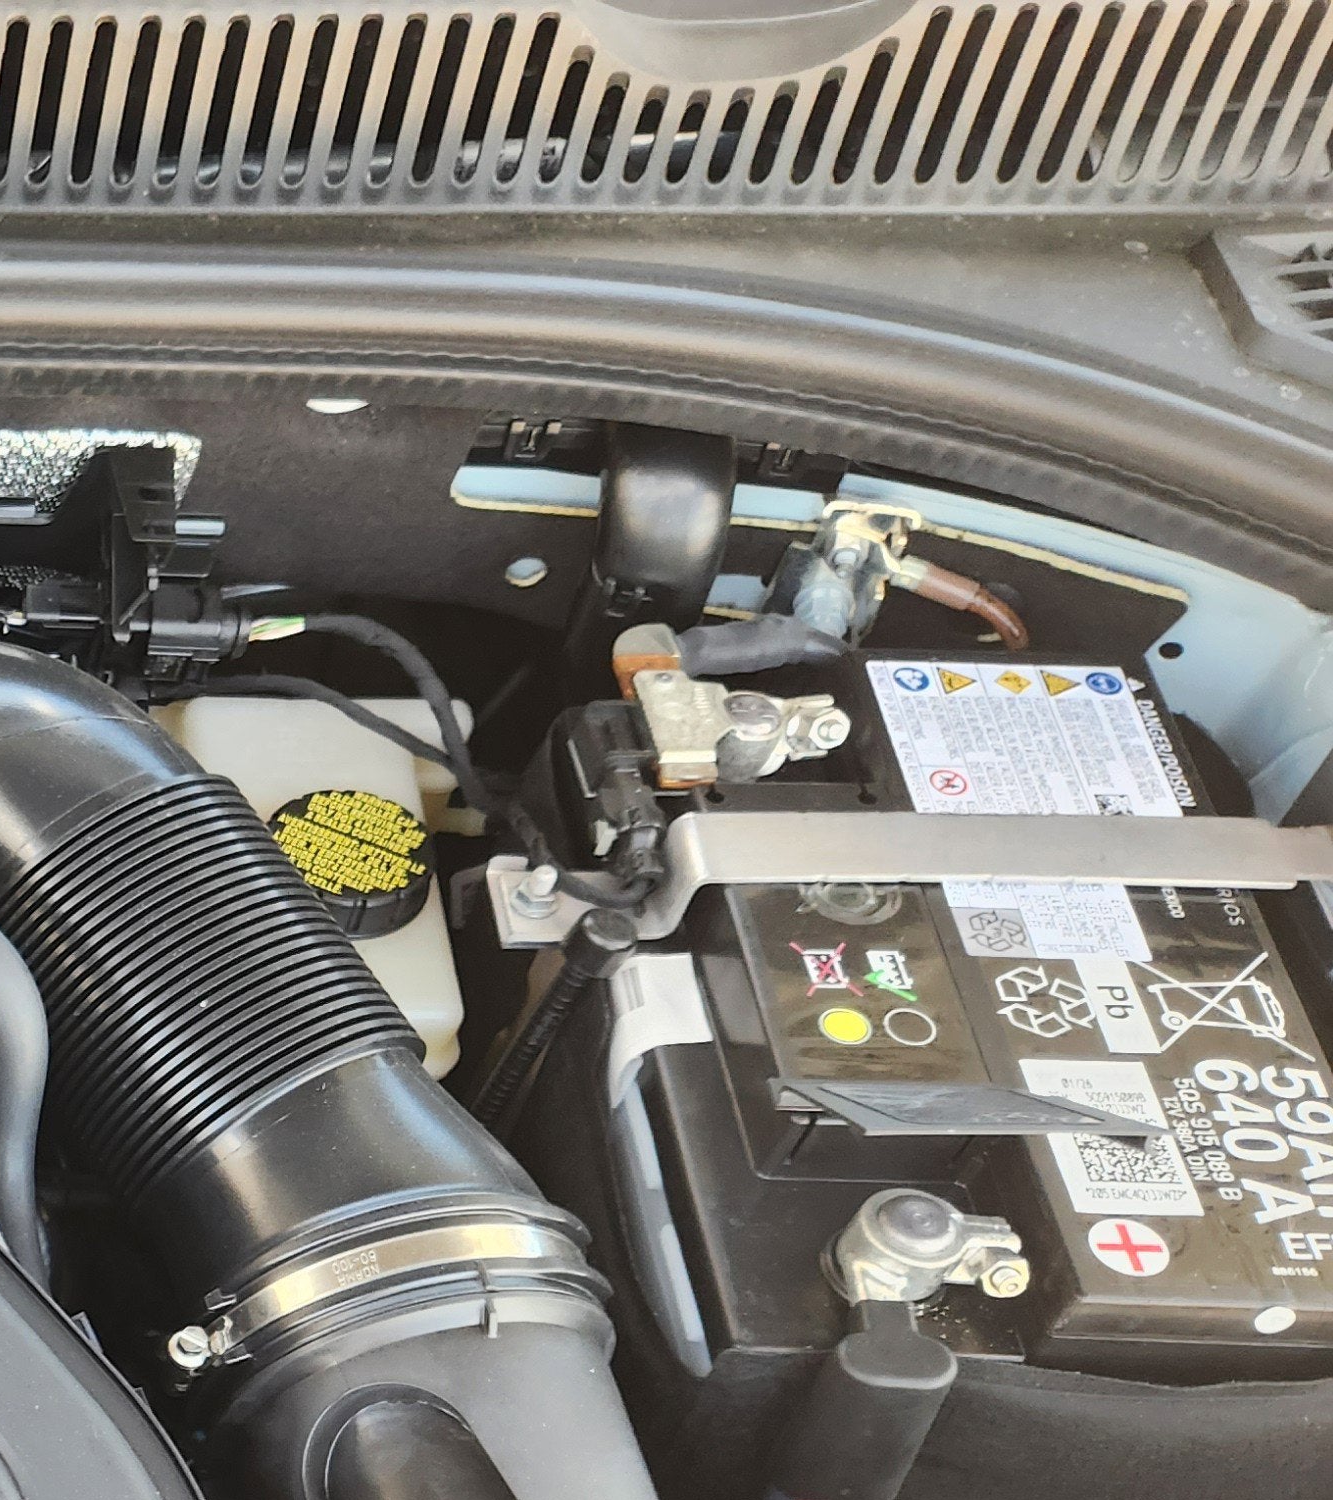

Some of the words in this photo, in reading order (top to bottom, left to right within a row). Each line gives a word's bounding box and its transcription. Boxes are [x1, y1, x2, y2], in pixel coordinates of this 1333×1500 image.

[1134, 699, 1196, 806] DANGER/POISON
[1095, 985, 1136, 1021] Pb
[1173, 1077, 1206, 1114] 5QS
[1194, 1058, 1289, 1162] 640
[1161, 1096, 1184, 1120] 12V
[1186, 1155, 1212, 1182] DIN
[1190, 1118, 1221, 1147] 915
[1203, 1150, 1235, 1183] 089
[1218, 1187, 1243, 1201] B
[1240, 1178, 1315, 1225] A
[1280, 1231, 1333, 1261] EF
